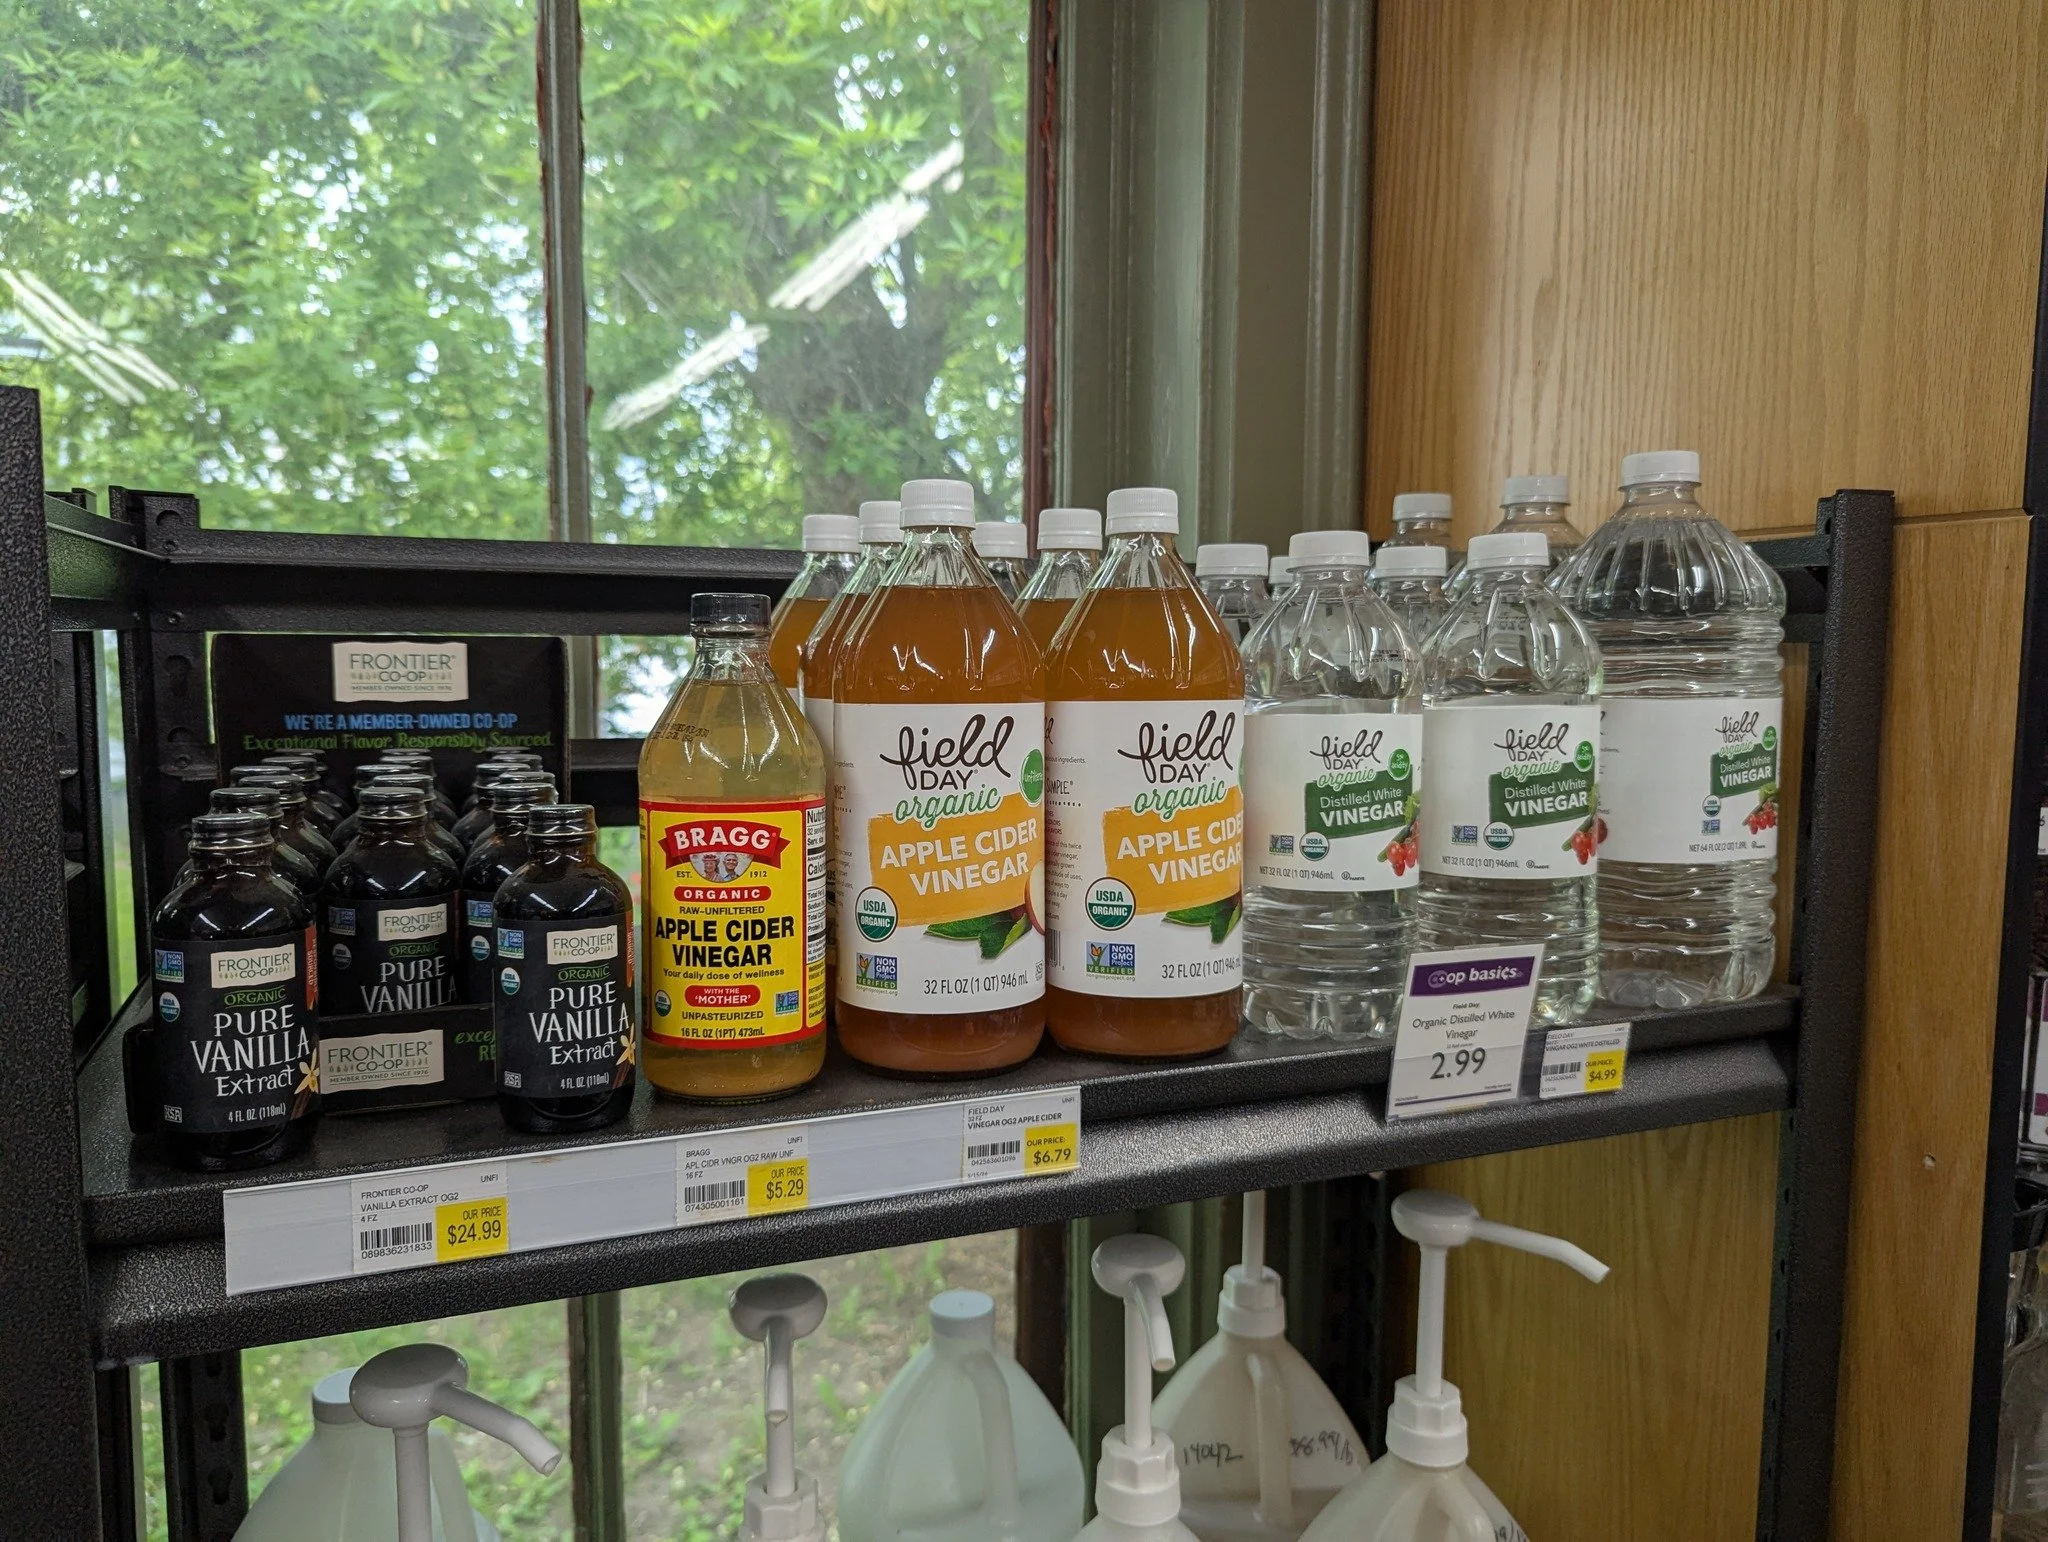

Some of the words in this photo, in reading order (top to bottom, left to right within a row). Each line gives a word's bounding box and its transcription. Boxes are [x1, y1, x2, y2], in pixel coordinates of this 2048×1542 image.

[350, 654, 452, 670] FRONTIER
[379, 671, 427, 682] CO-OP
[285, 714, 334, 731] WE'RE
[336, 715, 347, 731] A
[350, 714, 471, 731] MEMBER-OWNED
[473, 713, 518, 730] CO-OP
[1715, 711, 1759, 743] field
[243, 735, 338, 750] Exceptional
[399, 731, 486, 752] Responsibly
[1117, 709, 1236, 784] field
[1493, 722, 1569, 761] field
[1728, 734, 1745, 743] DAY
[879, 713, 1015, 790] field
[1310, 729, 1383, 770] field
[1518, 751, 1545, 761] DAY
[1160, 763, 1207, 784] DAY
[1333, 759, 1361, 770] DAY
[1502, 758, 1559, 781] organic
[1720, 759, 1750, 773] Distilled
[1751, 756, 1770, 766] White
[920, 769, 973, 790] DAY
[1319, 768, 1374, 790] organic
[1720, 766, 1771, 787] VINEGAR
[1505, 781, 1556, 799] Distilled
[1558, 778, 1586, 792] White
[895, 784, 1001, 828] organic
[1134, 776, 1228, 820] organic
[1320, 791, 1370, 808] Distilled
[1373, 788, 1402, 801] White
[1504, 791, 1588, 817] VINEGAR
[1320, 800, 1403, 827] VINEGAR
[674, 826, 770, 850] BRAGG
[880, 836, 968, 869] APPLE
[975, 818, 1038, 855] CIDER
[1117, 826, 1202, 860] APPLE
[1207, 810, 1243, 844] CIDE
[1148, 842, 1241, 885] VINEGAR
[910, 852, 1029, 896] VINEGAR
[684, 889, 760, 900] ORGANIC
[1096, 890, 1124, 903] USDA
[864, 900, 886, 913] USDA
[1092, 906, 1128, 916] ORGANIC
[655, 916, 717, 942] APPLE
[726, 916, 794, 942] CIDER
[861, 916, 890, 927] ORGANIC
[553, 934, 613, 949] FRONTIER
[571, 948, 600, 956] CO-OP
[672, 944, 772, 968] VINEGAR
[218, 953, 289, 972] FRONTIER
[876, 957, 896, 966] NON
[876, 965, 896, 974] GMO
[1088, 965, 1133, 975] VERIFIED
[239, 968, 275, 979] CO-OP
[558, 966, 609, 981] ORGANIC
[663, 968, 680, 977] Your
[683, 970, 704, 981] daily
[707, 971, 729, 980] dose
[733, 971, 743, 980] of
[745, 969, 785, 979] wellness
[857, 977, 896, 989] VERIFIED
[924, 980, 937, 995] 32
[941, 979, 953, 995] FL
[954, 979, 968, 994] OZ
[970, 977, 980, 996] (1
[983, 976, 1000, 992] QT)
[1000, 975, 1017, 989] 946
[1018, 973, 1028, 986] mL
[225, 989, 286, 1005] ORGANIC
[549, 981, 617, 1010] PURE
[214, 1004, 295, 1037] PURE
[528, 1003, 629, 1043] VANILLA
[682, 1011, 764, 1021] UNPASTEURIZED
[1412, 1017, 1447, 1030] Organic
[1450, 1012, 1485, 1025] Distilled
[1488, 1011, 1515, 1021] White
[681, 1028, 690, 1037] 16
[692, 1028, 700, 1037] FL
[703, 1028, 713, 1038] OZ
[715, 1028, 736, 1039] (1PT)
[738, 1027, 765, 1037] 473mL
[1446, 1029, 1478, 1040] Vinegar
[190, 1027, 310, 1074] VANILLA
[549, 1037, 617, 1065] Extract
[1594, 1039, 1620, 1047] DISTILLED
[328, 1041, 429, 1064] FRONTIER
[356, 1059, 403, 1072] CO-OP
[1430, 1047, 1486, 1080] 2.99
[215, 1065, 295, 1097] Extract
[1589, 1069, 1617, 1083] $4.99
[968, 1106, 988, 1115] FIELD
[989, 1105, 1005, 1113] DAY
[968, 1120, 1000, 1130] VINEGAR
[1018, 1115, 1040, 1124] APPLE
[1041, 1112, 1062, 1120] CIDER
[787, 1136, 803, 1144] UNFI
[1026, 1138, 1042, 1147] OUR
[1043, 1136, 1066, 1145] PRICE:
[685, 1161, 699, 1170] APL
[700, 1158, 720, 1169] CIDR
[721, 1156, 742, 1166] VNGR
[743, 1153, 760, 1163] OG2
[760, 1151, 778, 1160] RAW
[779, 1149, 794, 1159] UNF
[686, 1148, 710, 1158] BRAGG
[1033, 1148, 1071, 1166] $6.79
[480, 1174, 499, 1183] UNFI
[694, 1171, 703, 1179] FZ
[771, 1169, 784, 1179] OUR
[786, 1166, 804, 1177] PRICE
[361, 1188, 401, 1199] FRONTIER
[403, 1184, 429, 1195] CO-OP
[766, 1178, 804, 1201] $5.29
[361, 1201, 397, 1212] VANILLA
[398, 1195, 439, 1208] EXTRACT
[440, 1192, 459, 1202] OG2
[685, 1197, 745, 1213] 074305001161
[367, 1214, 378, 1222] FZ
[463, 1210, 477, 1220] OUR
[481, 1206, 501, 1218] PRICE
[448, 1220, 501, 1246] $24.99
[361, 1242, 432, 1259] 089836231833
